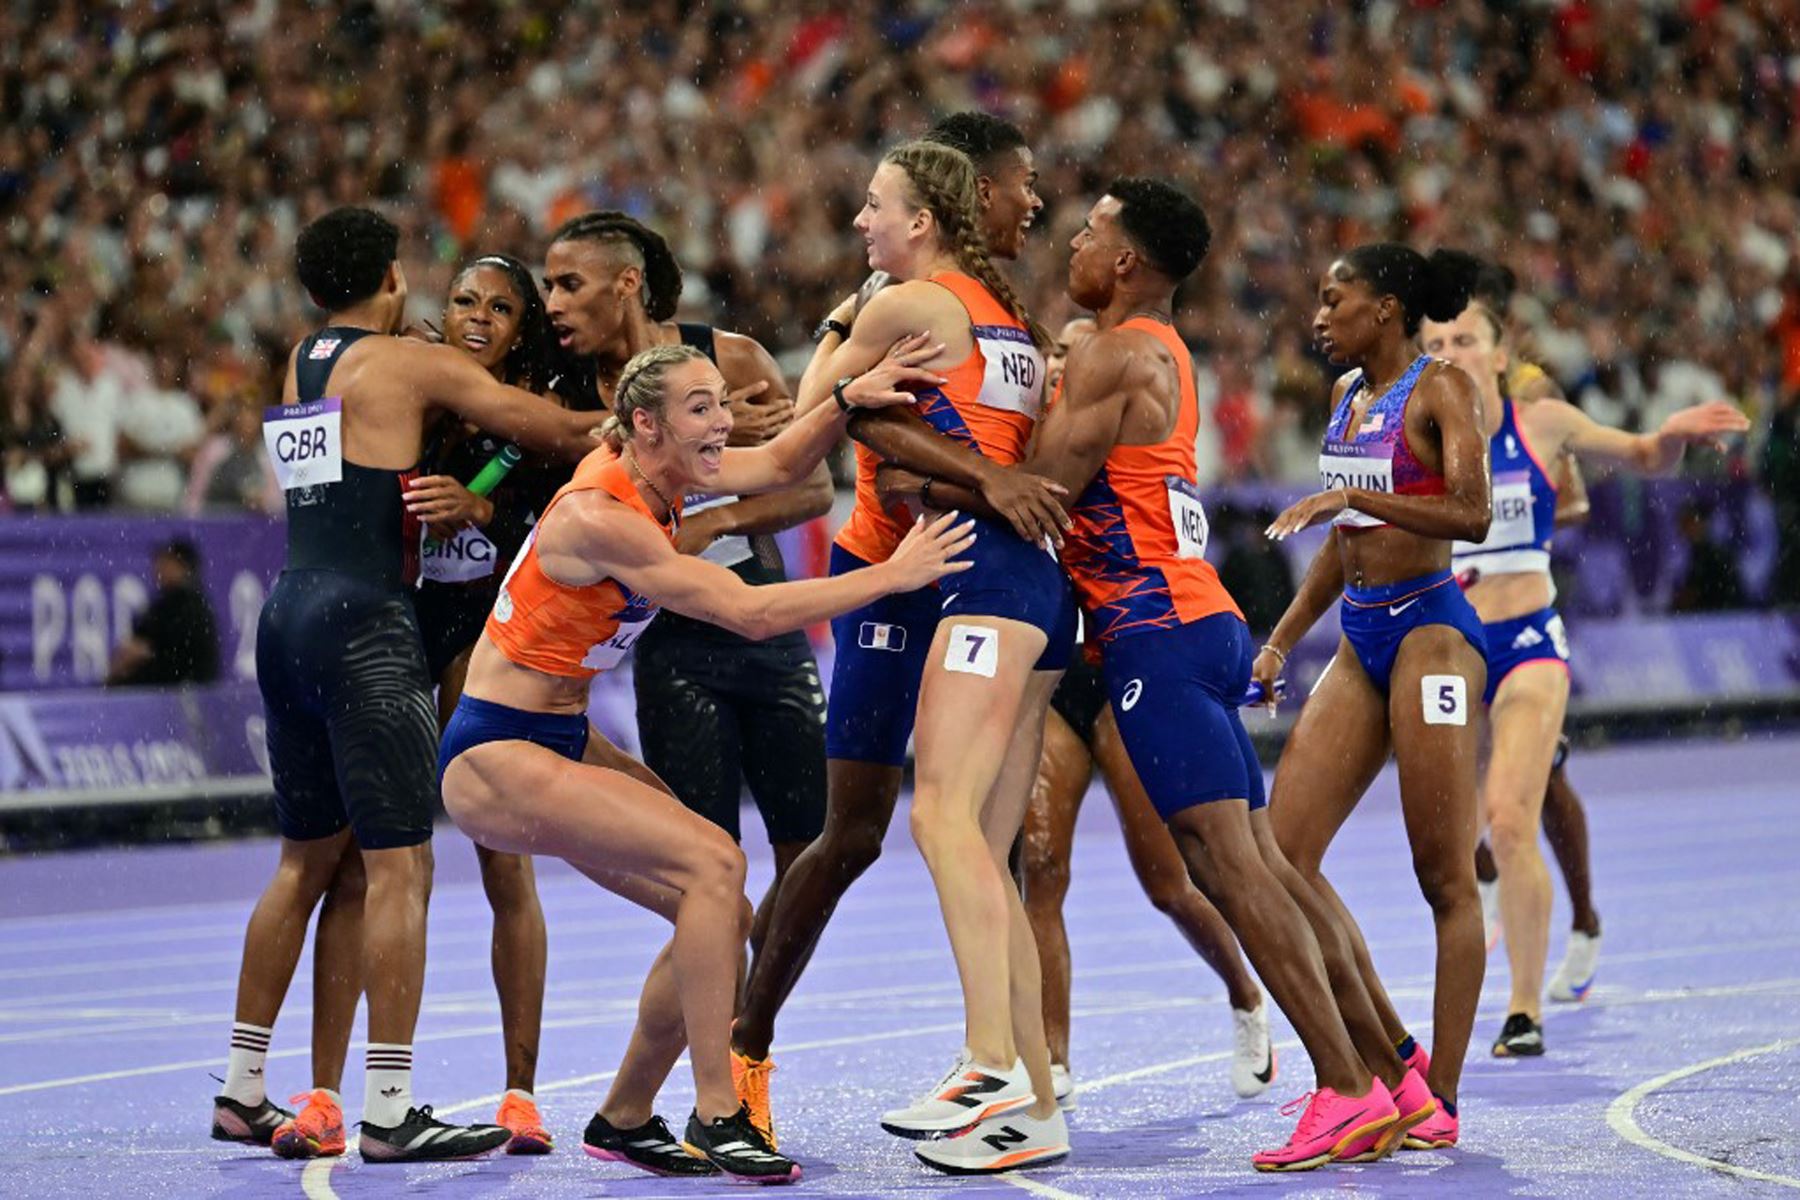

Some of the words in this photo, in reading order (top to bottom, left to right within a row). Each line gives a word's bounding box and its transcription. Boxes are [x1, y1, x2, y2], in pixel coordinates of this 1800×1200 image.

[1001, 352, 1035, 389] NED
[276, 426, 326, 462] GBR
[1181, 505, 1204, 546] NED
[1496, 497, 1527, 521] IER
[31, 571, 151, 683] PAR
[966, 635, 987, 664] 7
[1439, 685, 1456, 714] 5
